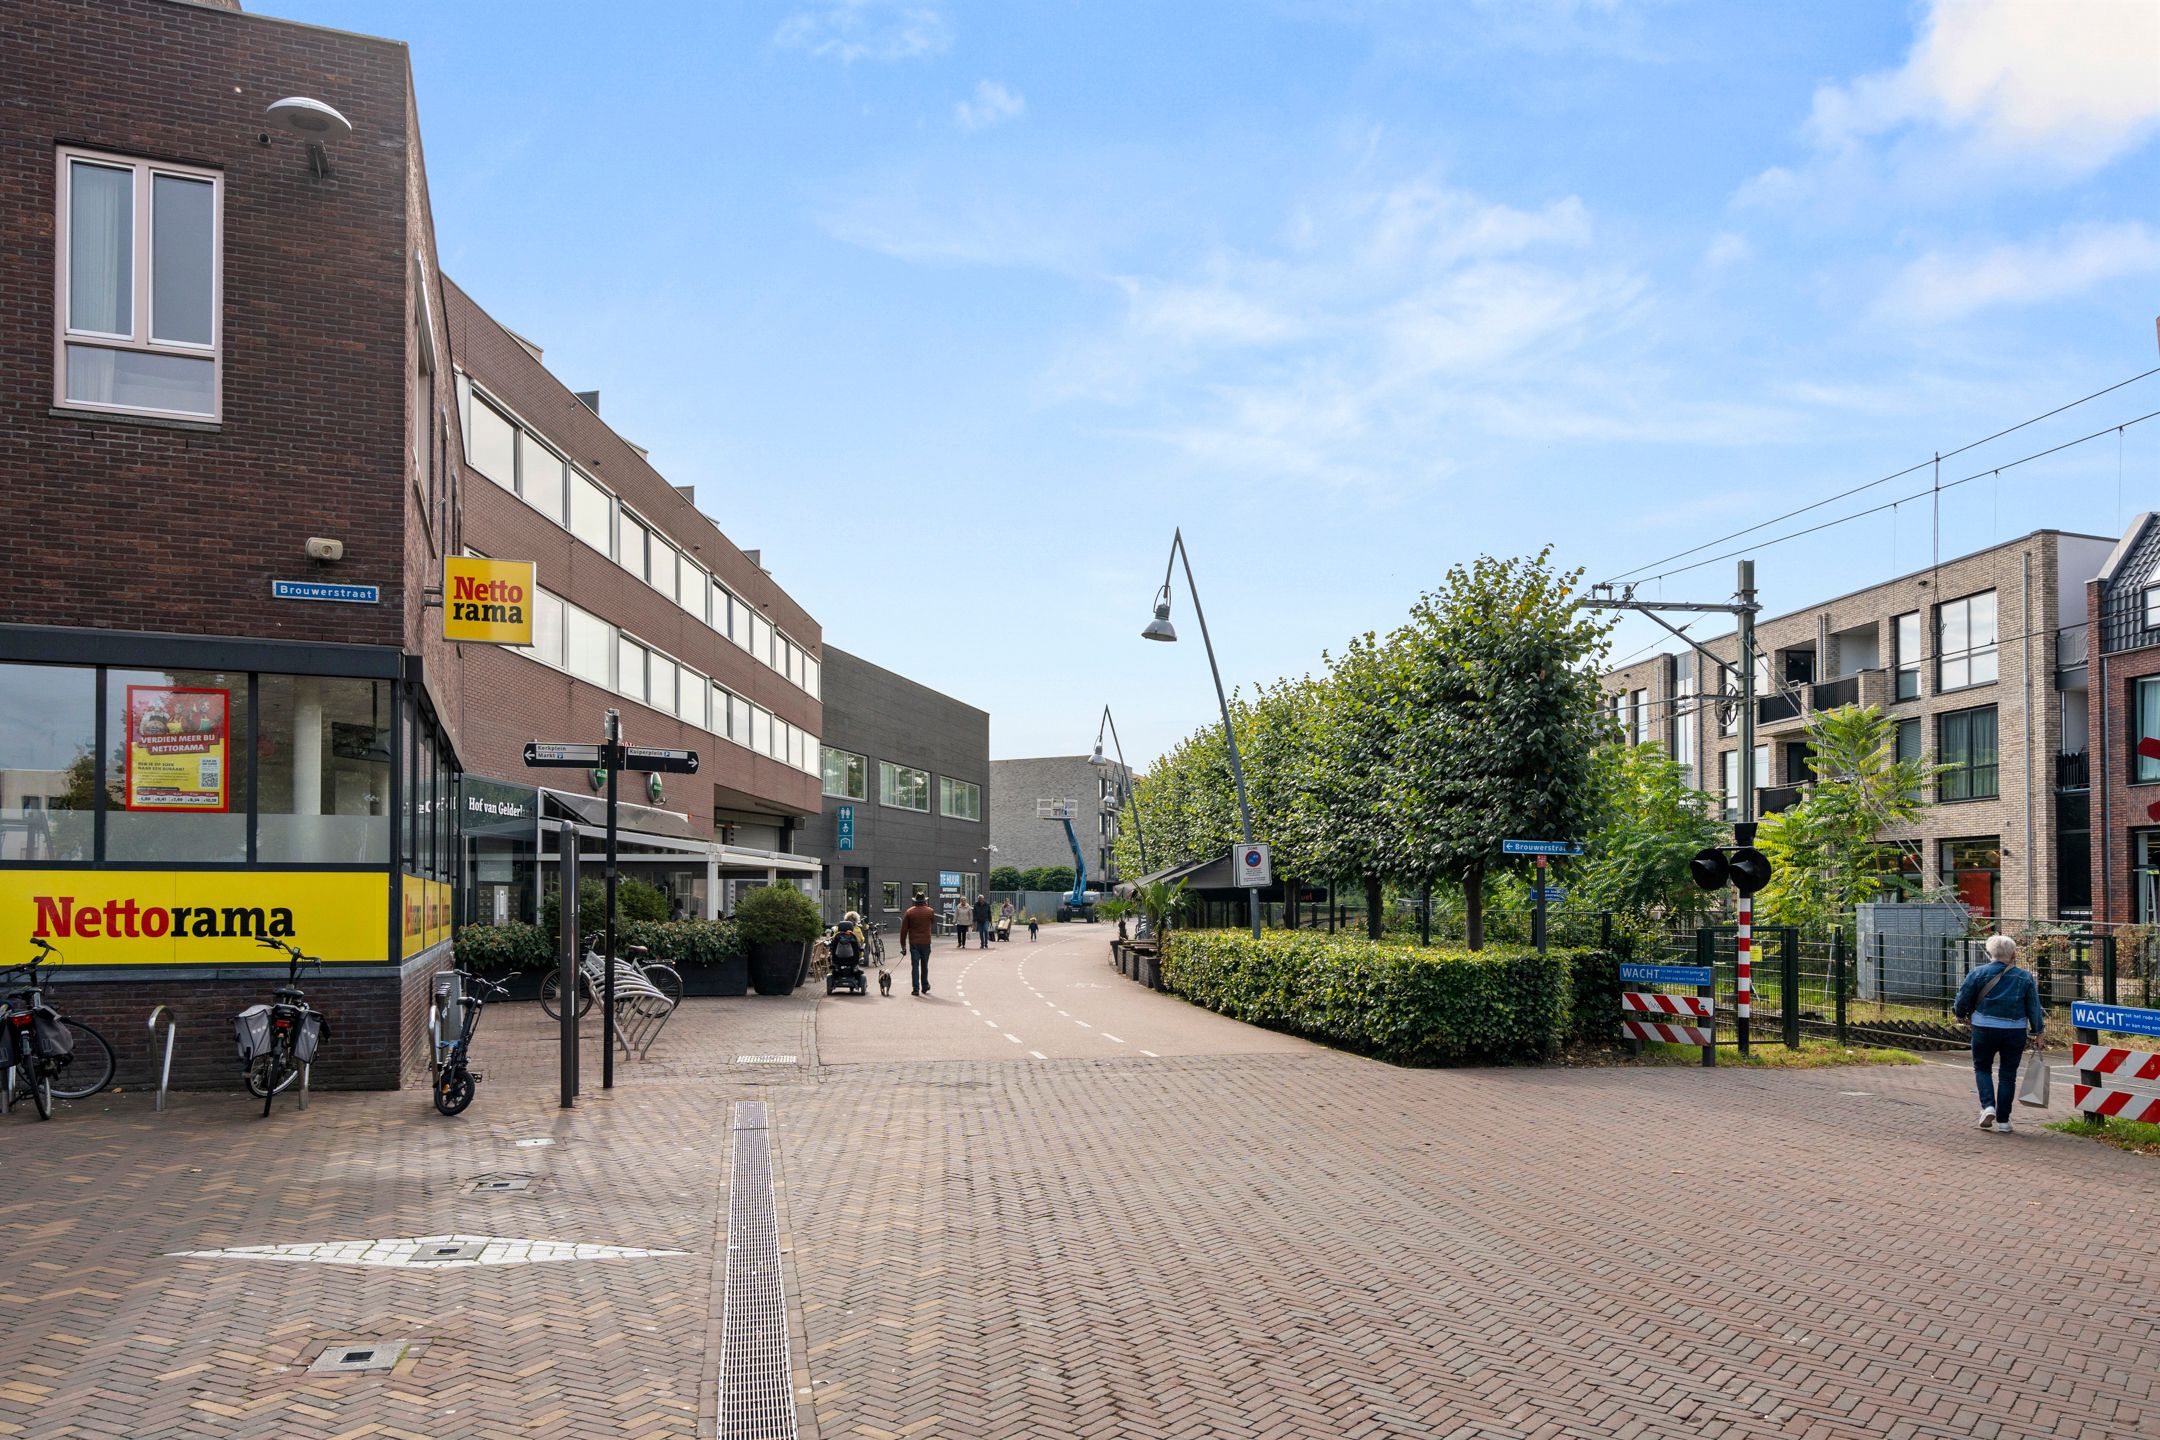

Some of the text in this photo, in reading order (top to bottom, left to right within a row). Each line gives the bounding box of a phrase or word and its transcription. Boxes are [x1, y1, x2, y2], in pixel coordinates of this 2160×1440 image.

[280, 585, 372, 599] Brouwerstraat
[453, 576, 523, 603] Netto
[453, 602, 523, 624] rama
[141, 736, 177, 744] VERDIEN
[152, 744, 204, 752] NETTORAMA
[629, 748, 663, 756] Kuiperplein
[468, 796, 484, 811] Hof
[484, 803, 497, 814] van
[498, 802, 532, 818] Gelderl
[1515, 843, 1567, 852] Brouwerstra
[941, 874, 960, 885] TE HUUR
[32, 896, 296, 938] Nettorama
[1622, 967, 1660, 979] WACHT
[2076, 1009, 2124, 1026] WACHT
